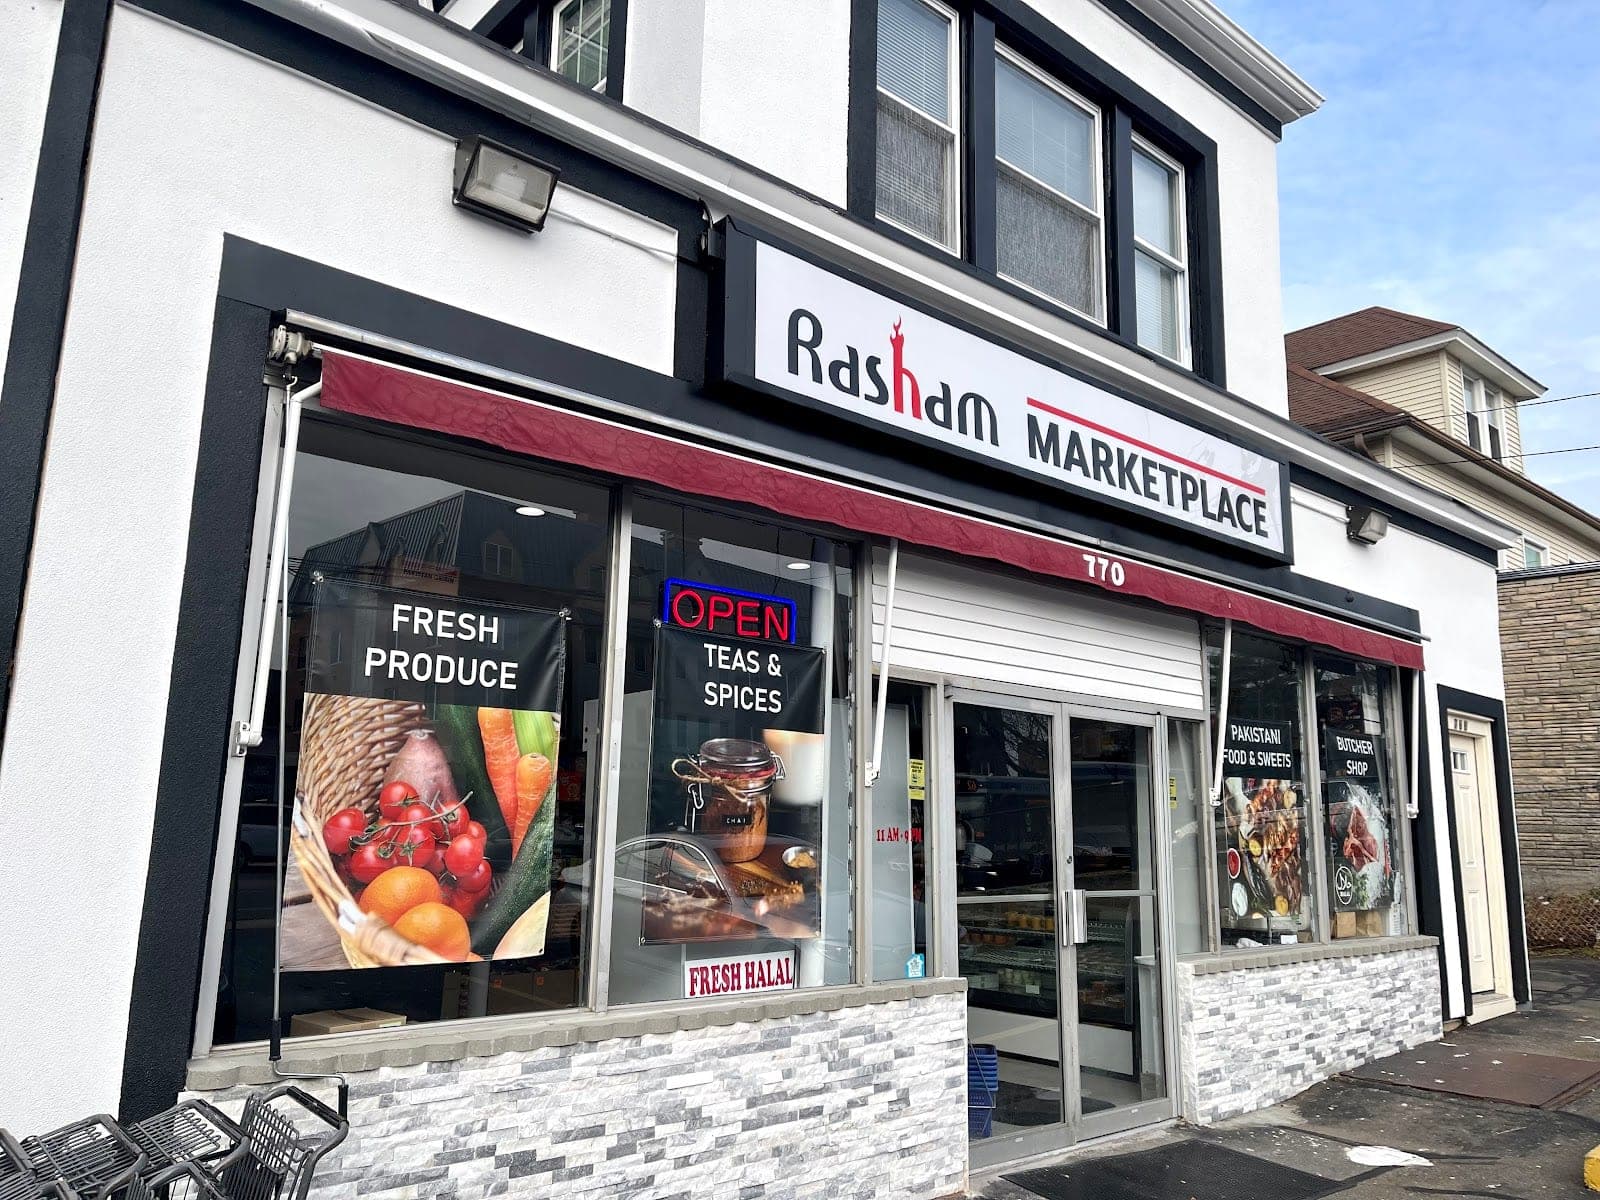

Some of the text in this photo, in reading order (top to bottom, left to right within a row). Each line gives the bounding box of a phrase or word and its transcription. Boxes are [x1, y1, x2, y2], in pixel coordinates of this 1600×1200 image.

[1027, 414, 1269, 538] MARKETPLACE
[1082, 553, 1125, 587] 770
[392, 603, 499, 644] FRESH
[672, 589, 789, 641] OPEN
[364, 647, 519, 690] PRODUCE
[703, 642, 782, 677] TEAS &
[704, 681, 782, 713] SPICES
[1231, 724, 1281, 745] PAKISTANI
[1336, 735, 1374, 756] BUTCHER
[1249, 750, 1256, 766] &
[1257, 751, 1292, 768] SWEETS
[1346, 759, 1368, 776] SHOP
[887, 827, 899, 842] AM
[689, 957, 793, 996] FRESH HALAL
